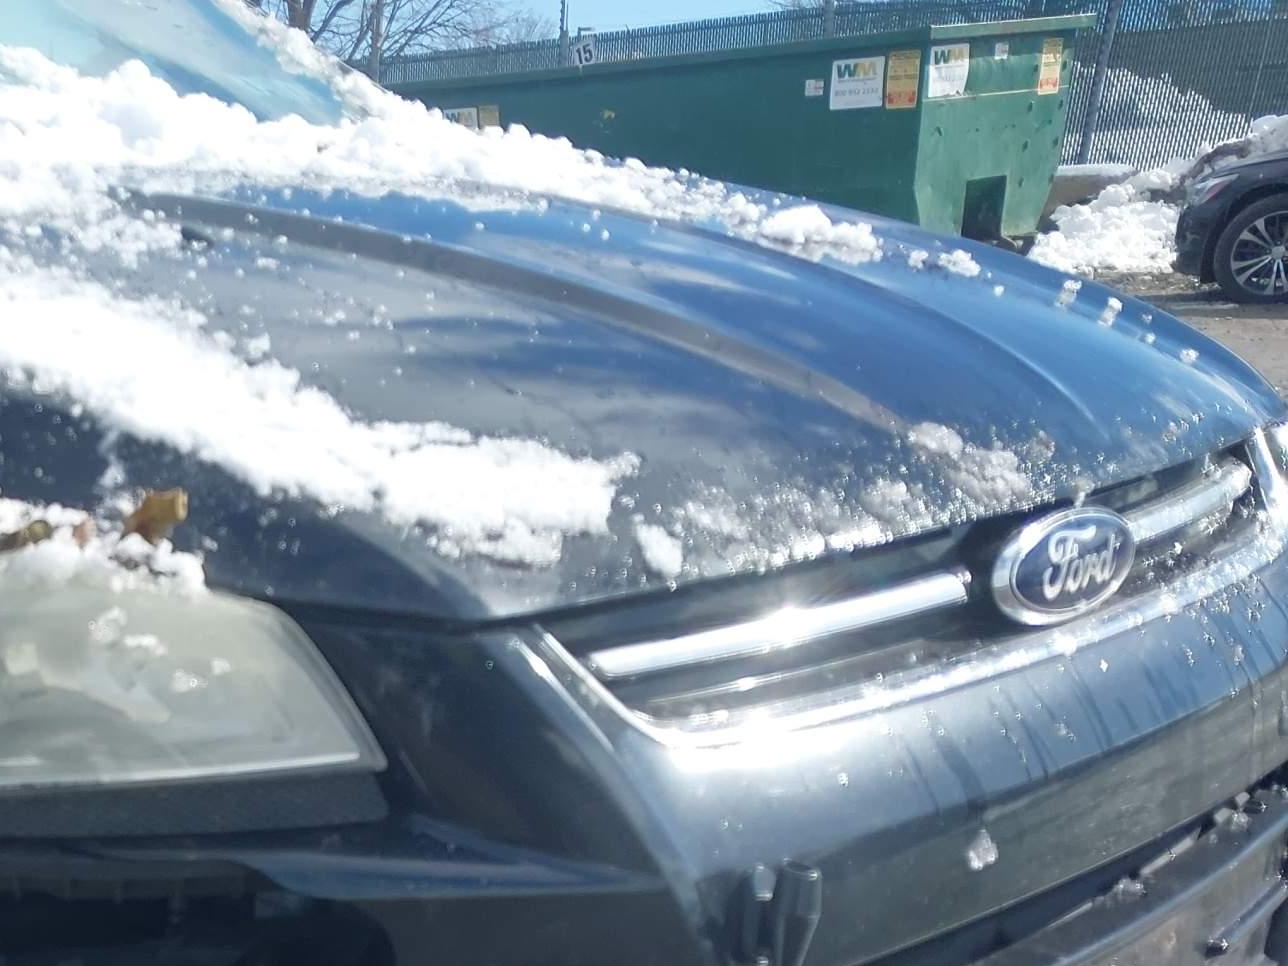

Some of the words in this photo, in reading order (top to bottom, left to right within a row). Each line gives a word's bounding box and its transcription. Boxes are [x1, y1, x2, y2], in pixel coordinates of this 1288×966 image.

[576, 43, 593, 65] 15
[836, 62, 877, 79] WM
[1042, 525, 1118, 601] Ford
